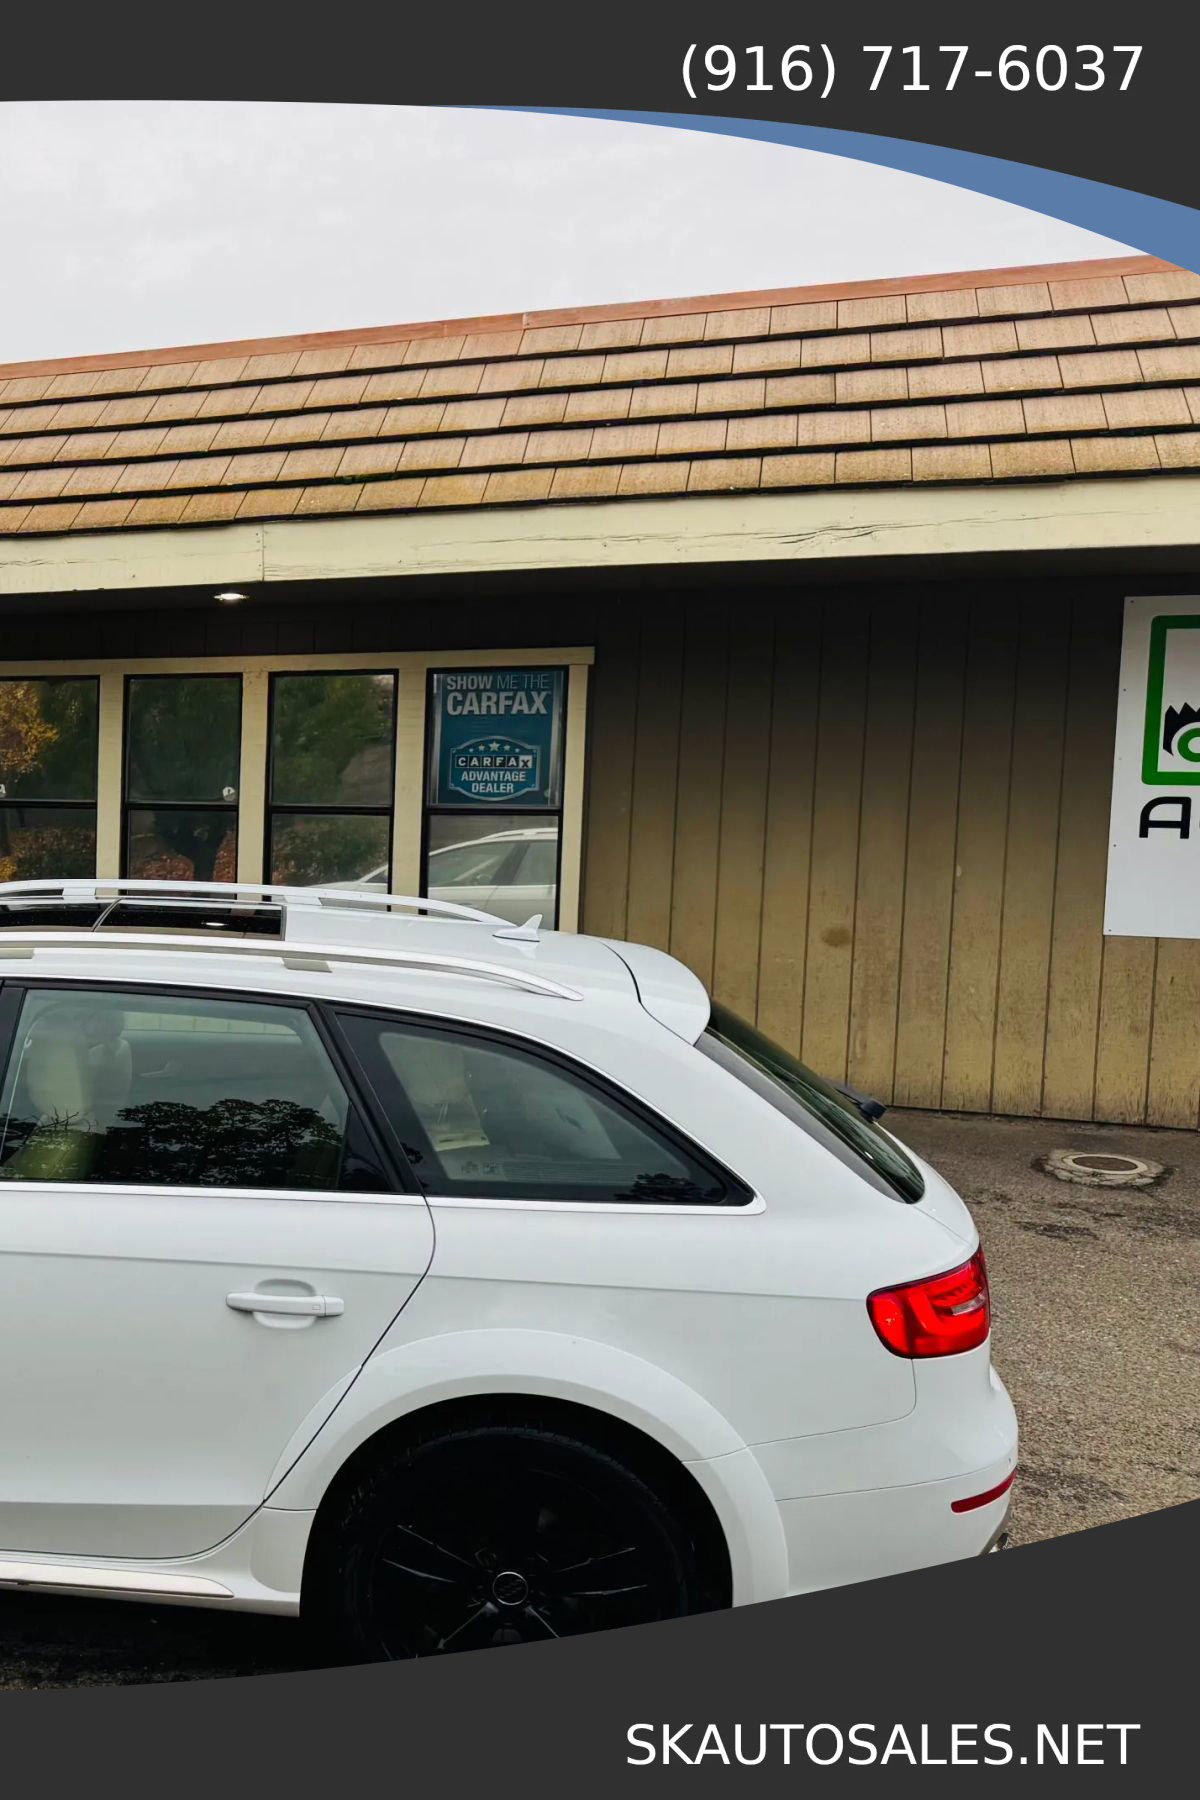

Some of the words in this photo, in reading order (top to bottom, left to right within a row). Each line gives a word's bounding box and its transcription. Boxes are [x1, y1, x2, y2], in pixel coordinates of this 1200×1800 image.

[446, 675, 492, 691] SHOW
[496, 674, 519, 690] ME
[522, 673, 549, 690] THE
[446, 691, 548, 716] CARFAX
[457, 756, 531, 768] CARFAX
[461, 770, 527, 782] ADVANTAGE
[471, 782, 514, 793] DEALER
